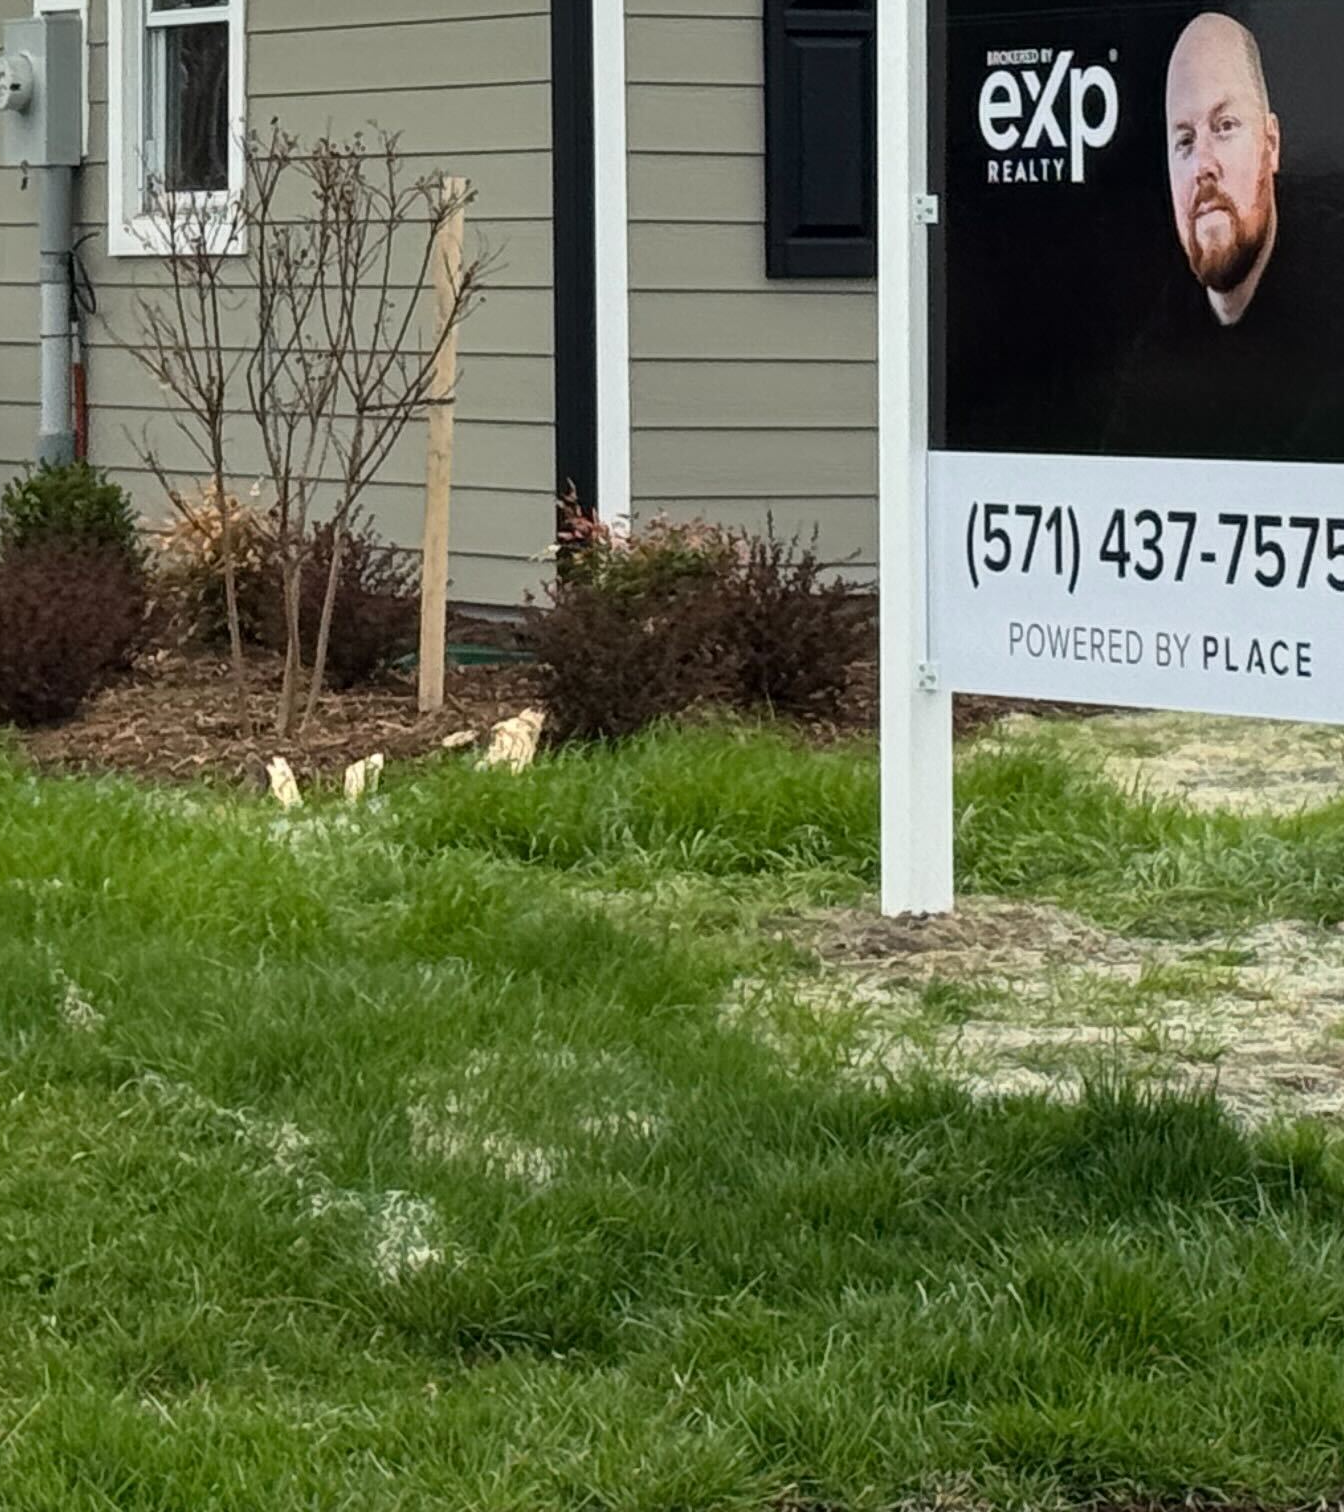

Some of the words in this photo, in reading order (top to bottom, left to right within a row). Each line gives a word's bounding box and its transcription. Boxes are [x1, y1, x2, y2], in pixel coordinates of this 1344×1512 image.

[987, 50, 1039, 66] BROKERED
[1040, 48, 1054, 64] BY
[987, 158, 1066, 184] REALTY
[966, 500, 1081, 594] (571)
[1008, 622, 1144, 665] POWERED
[1155, 632, 1192, 668] BY
[1202, 635, 1313, 678] PLACE
